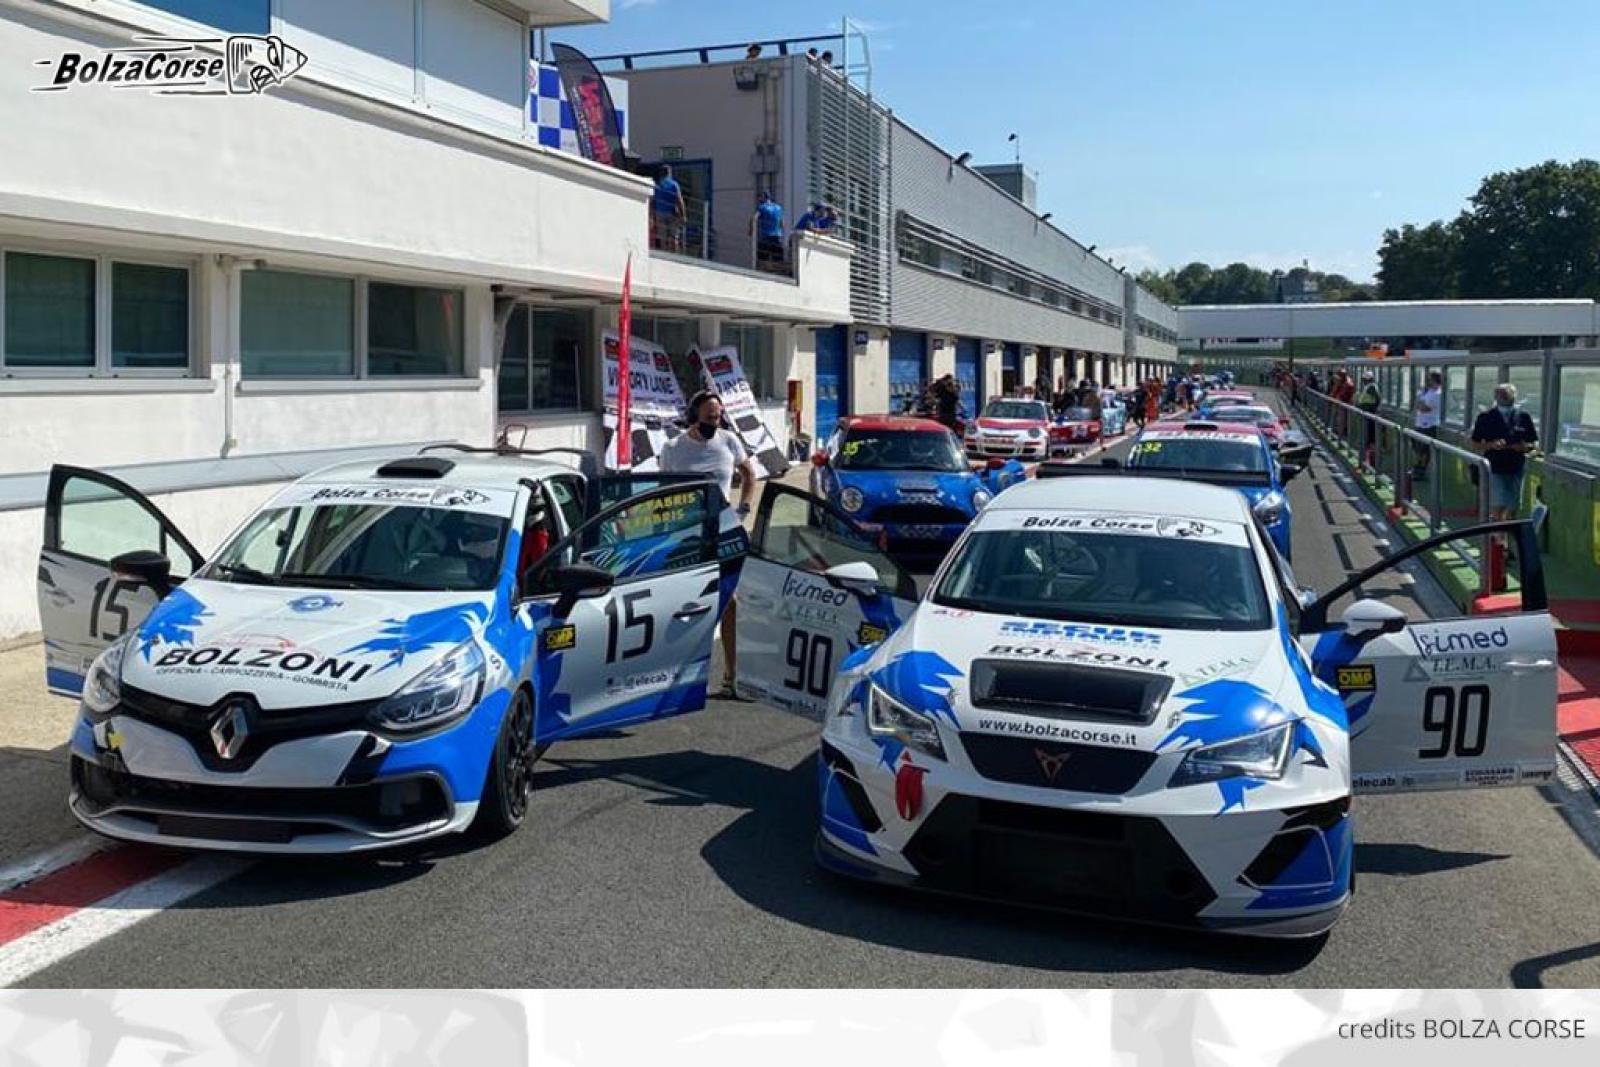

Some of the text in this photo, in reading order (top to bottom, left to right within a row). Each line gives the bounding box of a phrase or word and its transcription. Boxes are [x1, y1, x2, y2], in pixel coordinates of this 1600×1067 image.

[311, 487, 430, 501] Bolza Corse
[1022, 516, 1153, 530] Bolza Corse
[90, 577, 141, 642] 15
[604, 589, 654, 665] 15
[154, 647, 373, 683] BOLZONI
[784, 627, 833, 698] 90
[1339, 671, 1372, 686] OMP
[978, 719, 1137, 746] www.bolzacorse.it
[1419, 684, 1490, 759] 90
